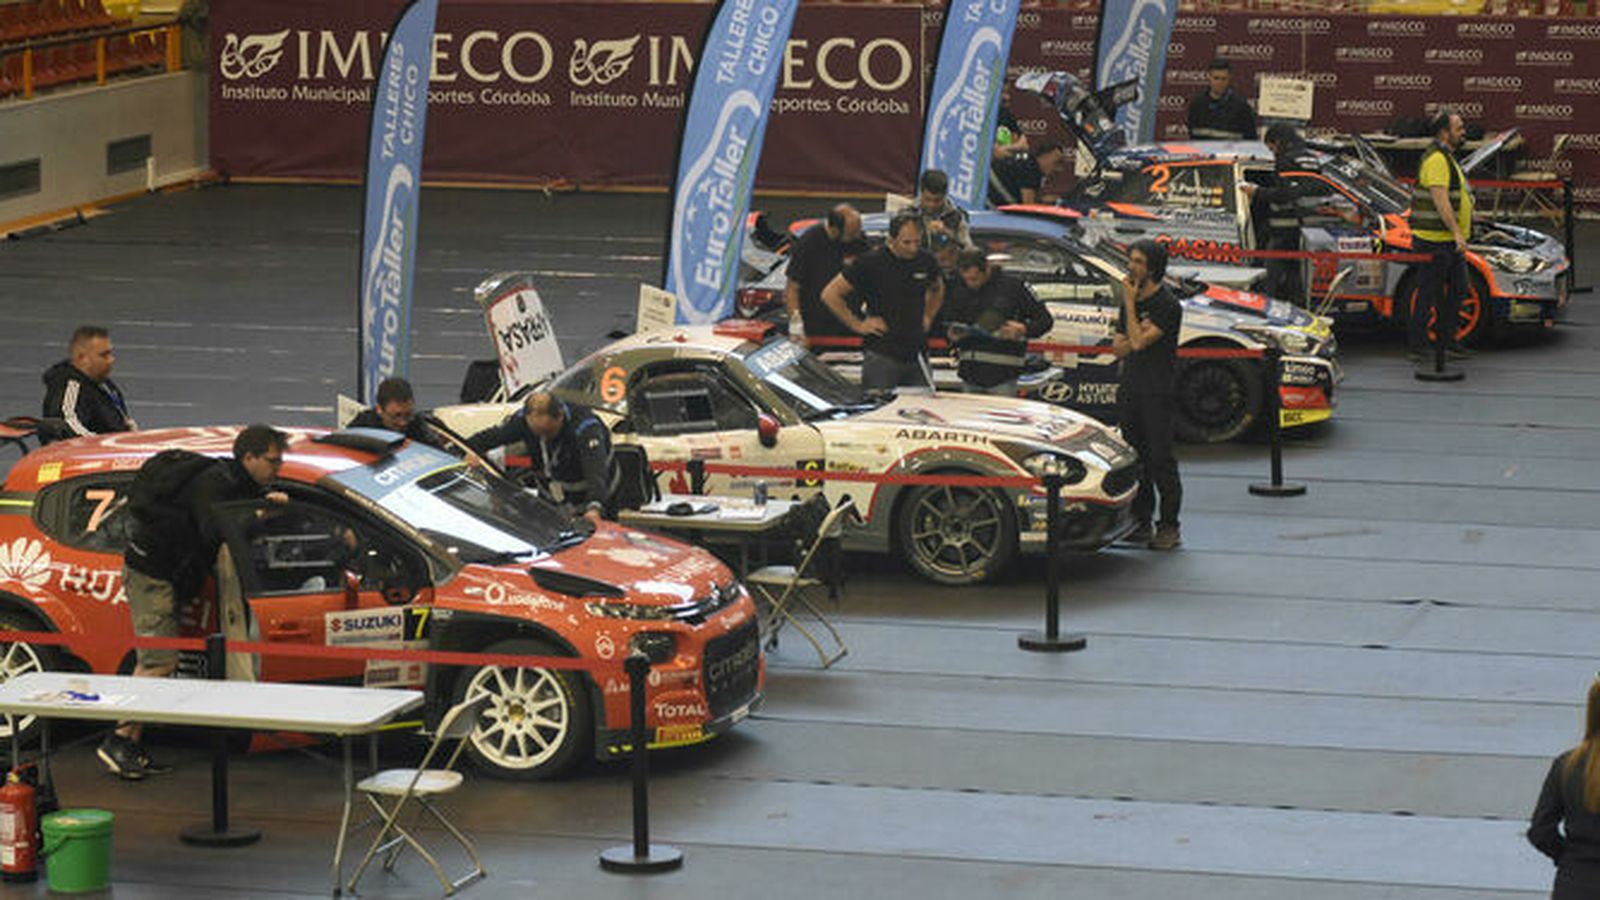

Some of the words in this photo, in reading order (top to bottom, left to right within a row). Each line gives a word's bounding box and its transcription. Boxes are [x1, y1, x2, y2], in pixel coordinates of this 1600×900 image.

[747, 6, 779, 76] CHICO
[1470, 23, 1515, 34] IMDECO
[297, 30, 553, 82] IMECO
[1528, 52, 1574, 63] IMDECO
[222, 85, 287, 101] Instituto
[292, 87, 370, 105] Municipal
[1476, 77, 1522, 87] IMDECO
[382, 41, 404, 159] TALLERES
[401, 64, 418, 146] CHICO
[571, 91, 637, 107] Instituto
[1349, 100, 1394, 111] IMDECO
[1528, 105, 1574, 116] IMDECO
[949, 58, 992, 201] EuroTaller
[1149, 164, 1170, 192] 2
[695, 125, 748, 290] EuroTaller
[380, 205, 405, 384] uroTaller
[601, 366, 628, 404] 6
[896, 427, 993, 446] ABARTH
[85, 488, 116, 533] 7
[343, 614, 402, 632] SUZUKI
[411, 607, 431, 641] 7
[654, 702, 706, 718] TOTAL
